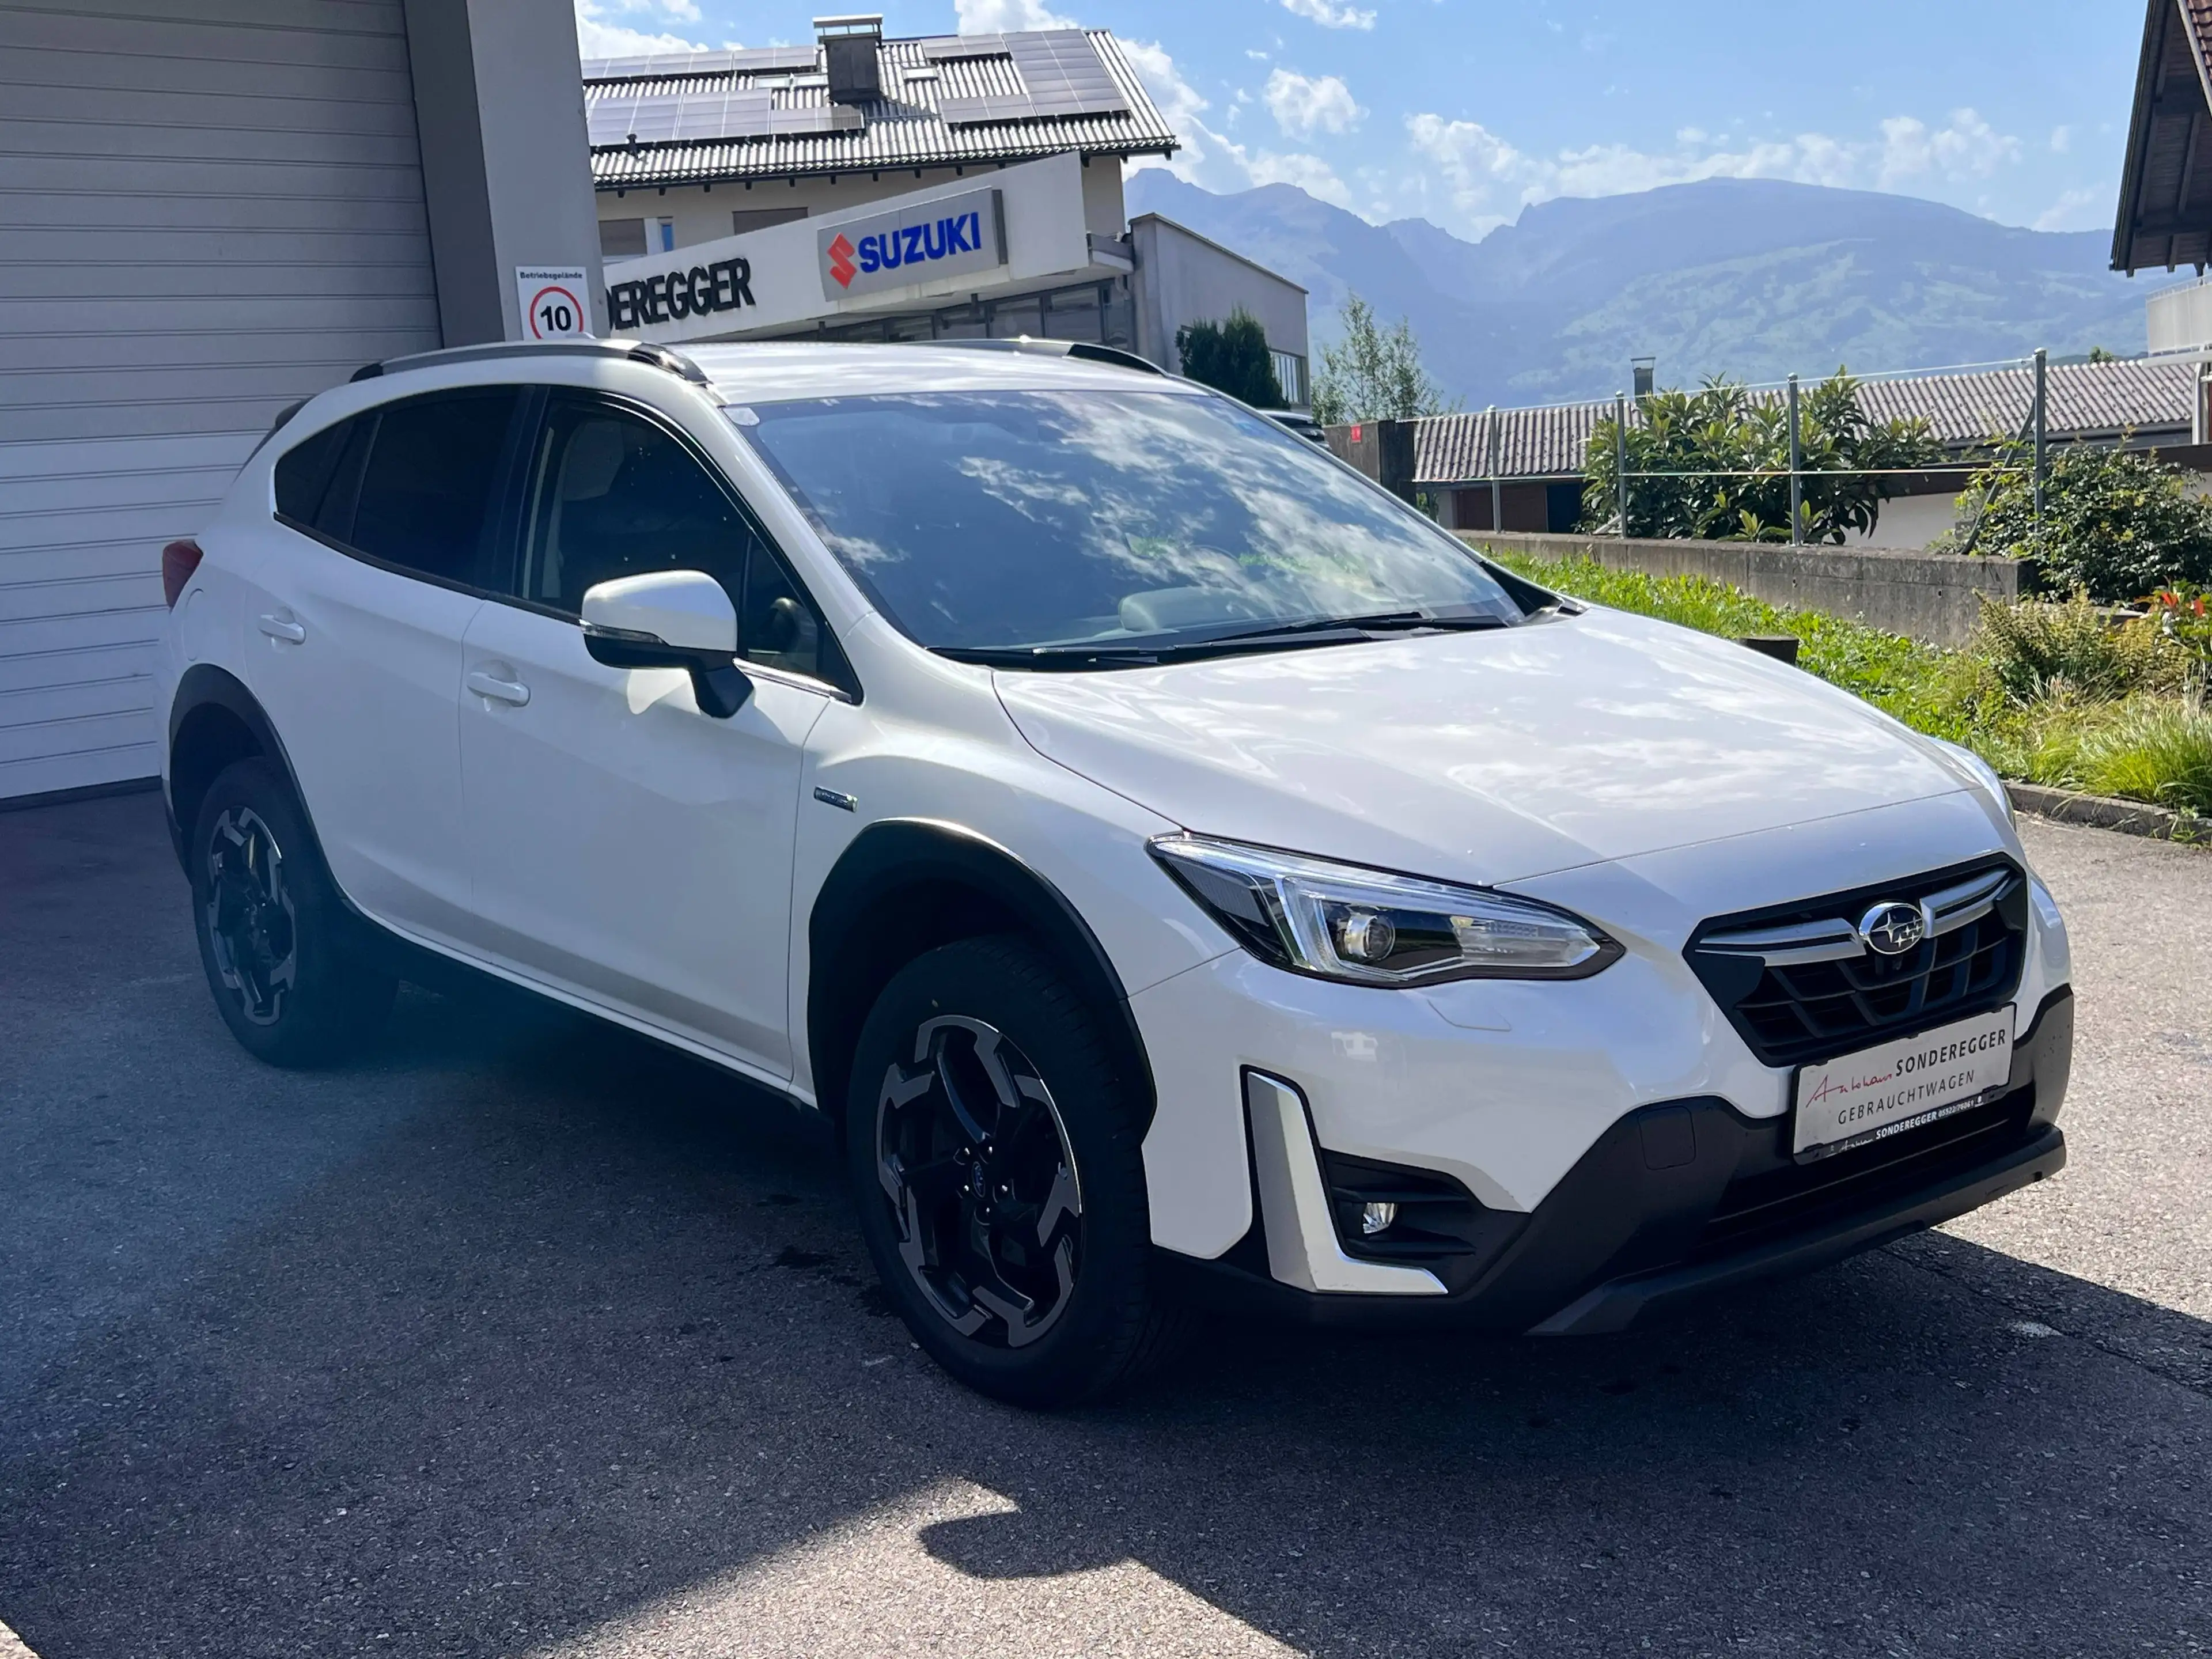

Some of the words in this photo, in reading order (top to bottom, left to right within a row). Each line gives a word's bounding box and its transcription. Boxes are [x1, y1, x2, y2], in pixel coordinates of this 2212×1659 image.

[858, 211, 982, 273] SUZUKI
[520, 271, 583, 281] Betriebsgelände
[541, 305, 571, 331] 10
[1896, 1029, 2005, 1077] SONDEREGGER
[1838, 1070, 1975, 1124] GEBRAUCHTWAGEN
[1876, 1111, 1937, 1140] SONDEREGGER
